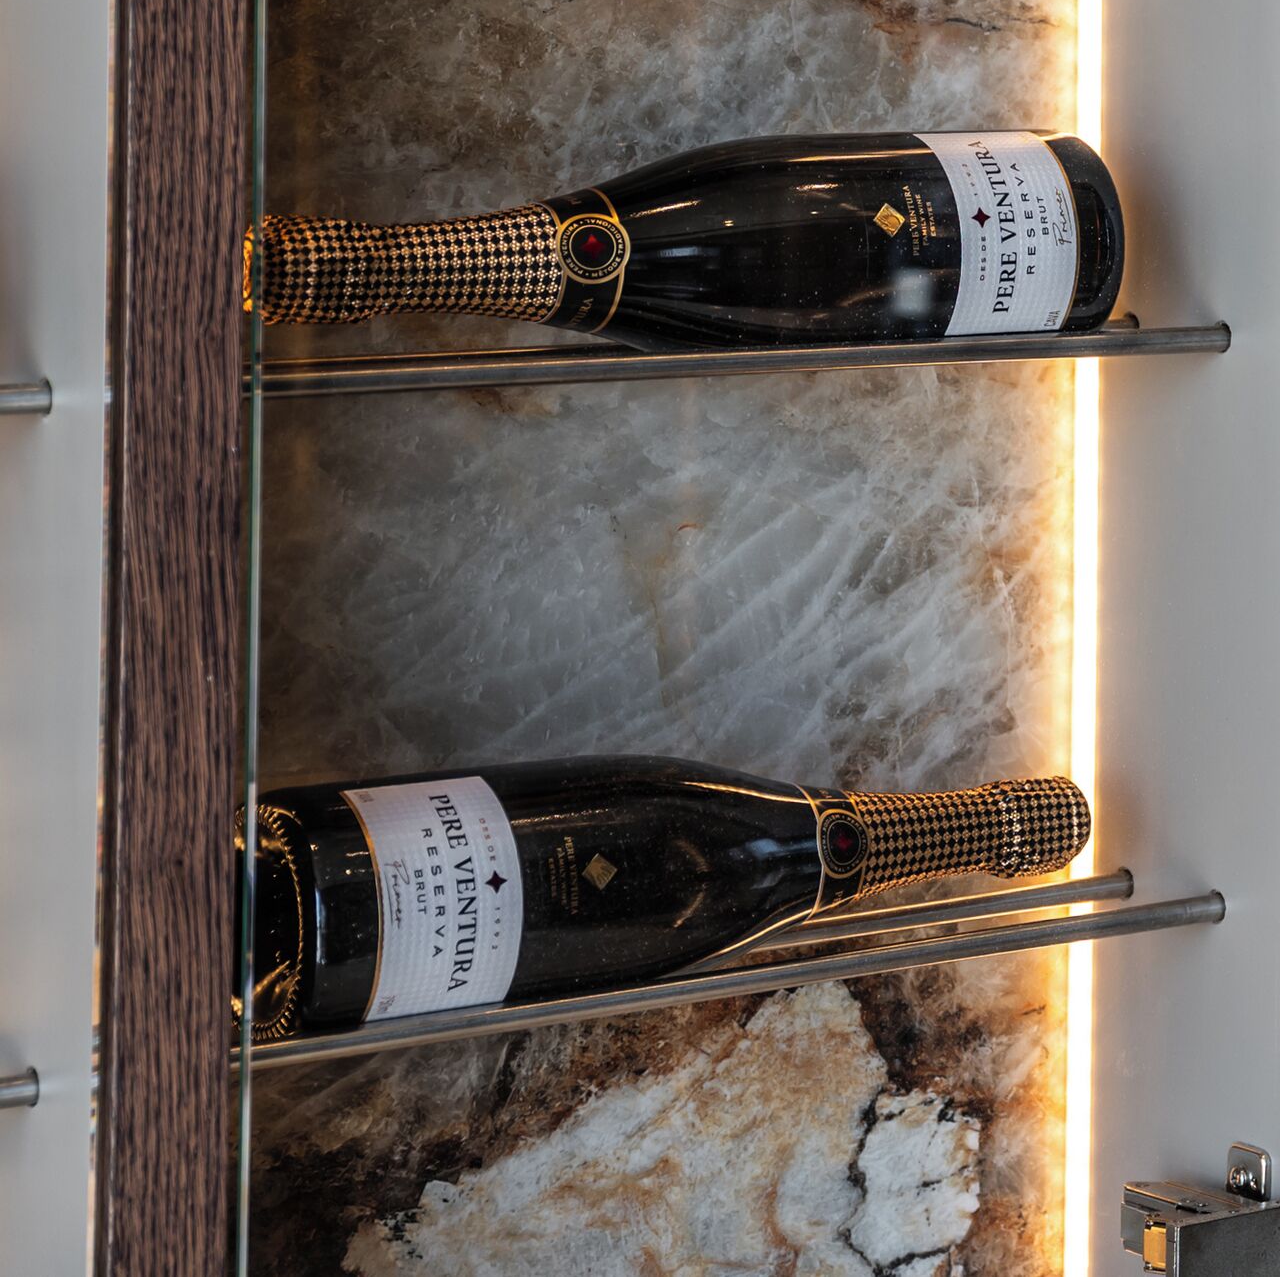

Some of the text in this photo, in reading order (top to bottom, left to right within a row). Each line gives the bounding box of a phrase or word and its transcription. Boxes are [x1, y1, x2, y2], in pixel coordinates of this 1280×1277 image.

[902, 185, 918, 229] VENTURA
[968, 140, 1017, 314] PERE VENTURA
[1010, 162, 1036, 275] RESERVA
[1036, 197, 1050, 236] BRUT
[414, 869, 428, 915] BRUT
[421, 827, 446, 959] RESERVA
[429, 794, 477, 992] PERE VENTURA
